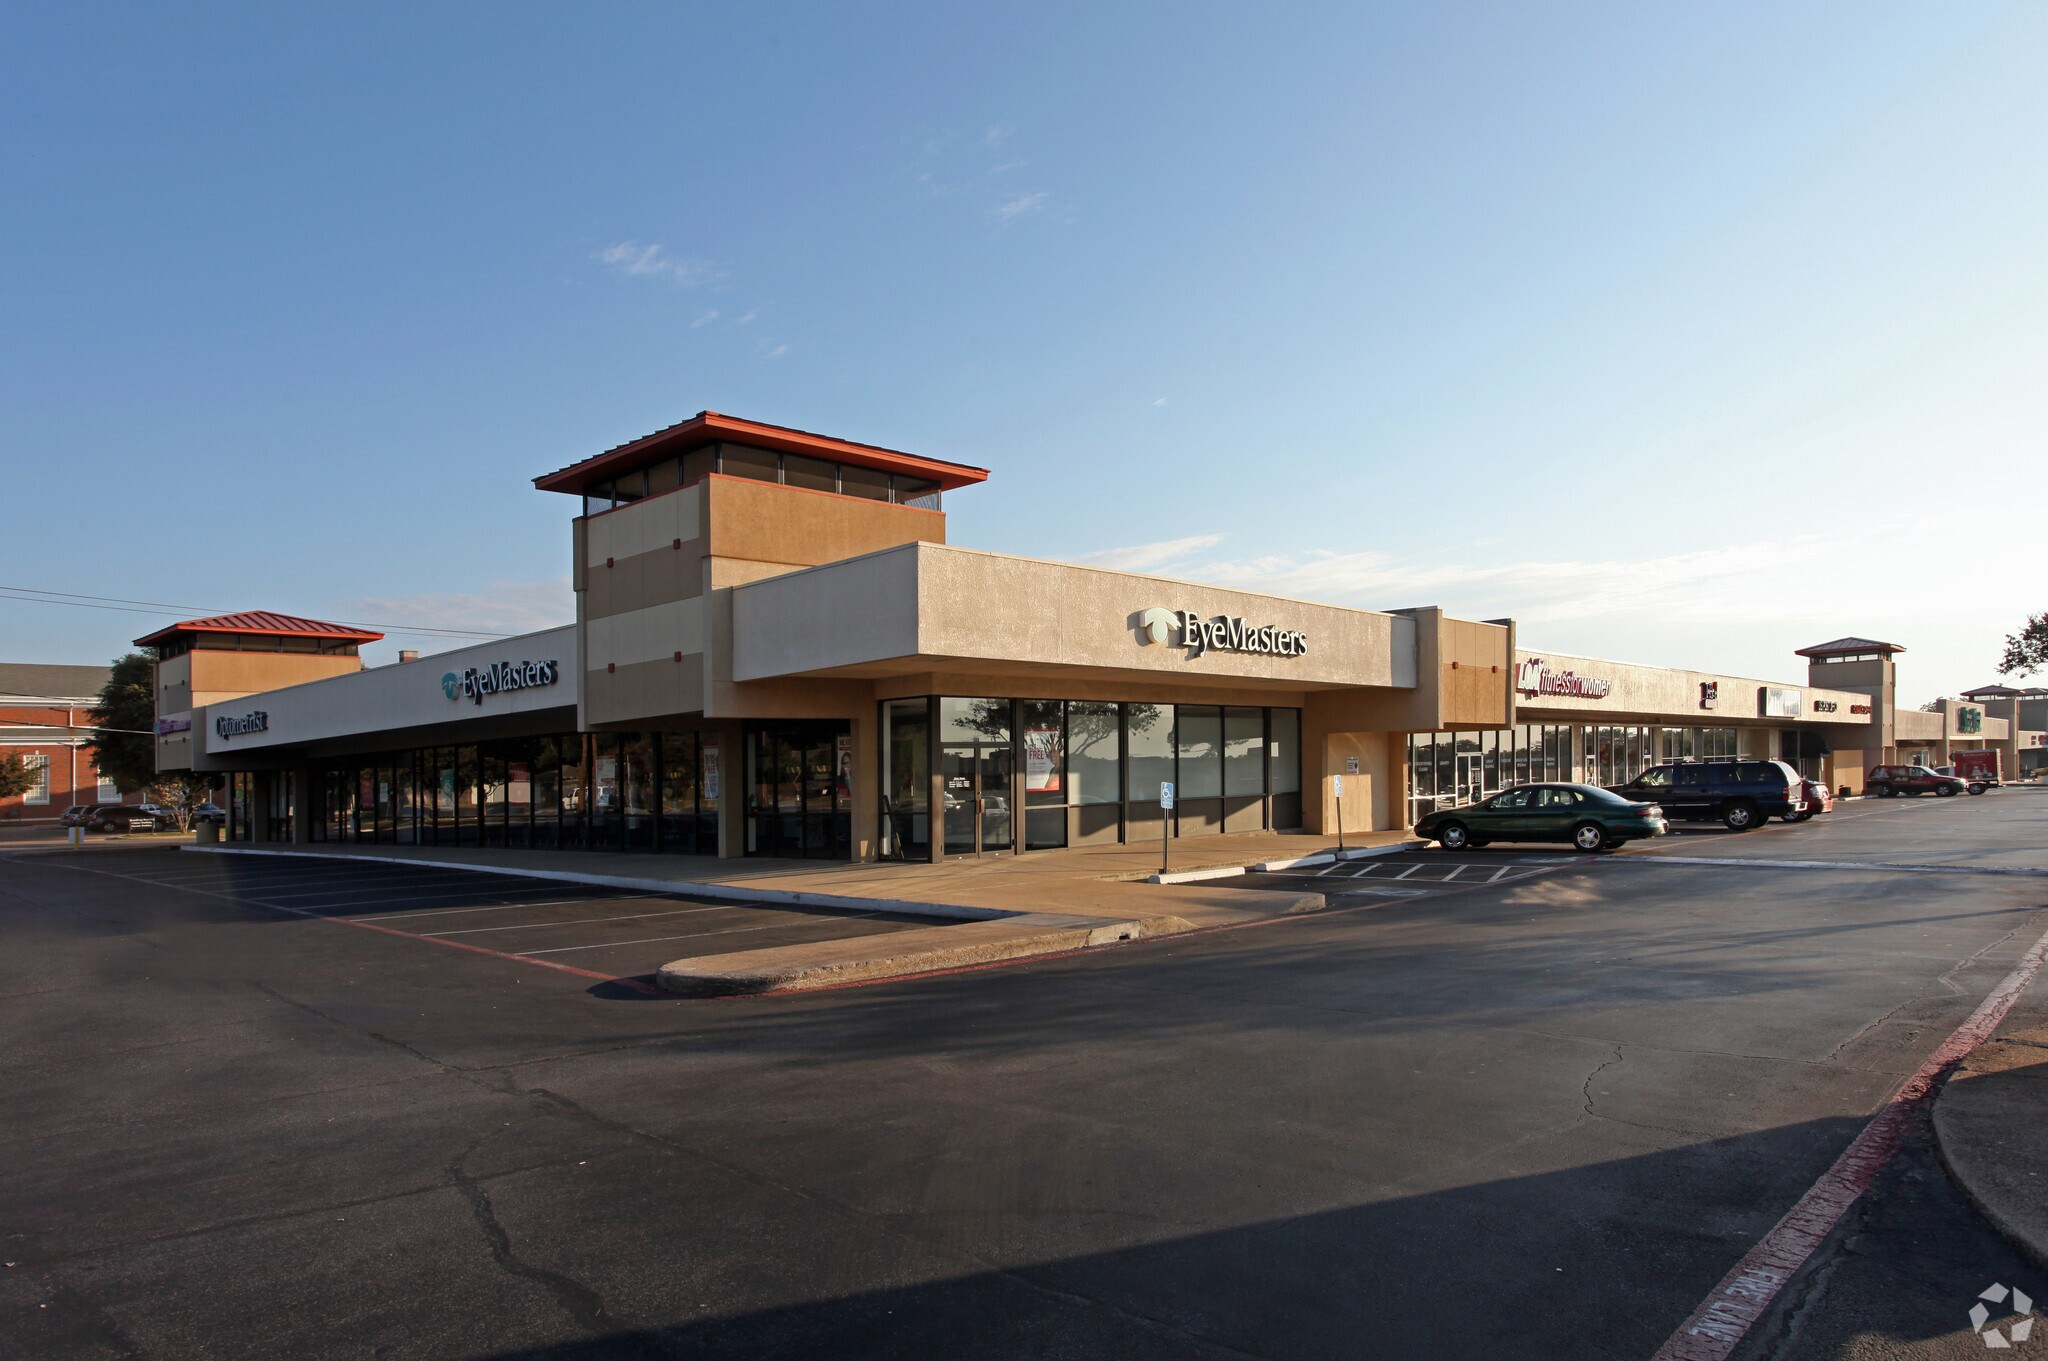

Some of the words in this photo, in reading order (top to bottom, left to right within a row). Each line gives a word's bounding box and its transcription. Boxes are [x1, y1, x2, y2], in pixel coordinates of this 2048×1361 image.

[1181, 610, 1309, 657] EyeMasters
[462, 660, 556, 705] EyeMasters
[217, 711, 267, 740] Optometrist
[1029, 750, 1044, 760] FREE
